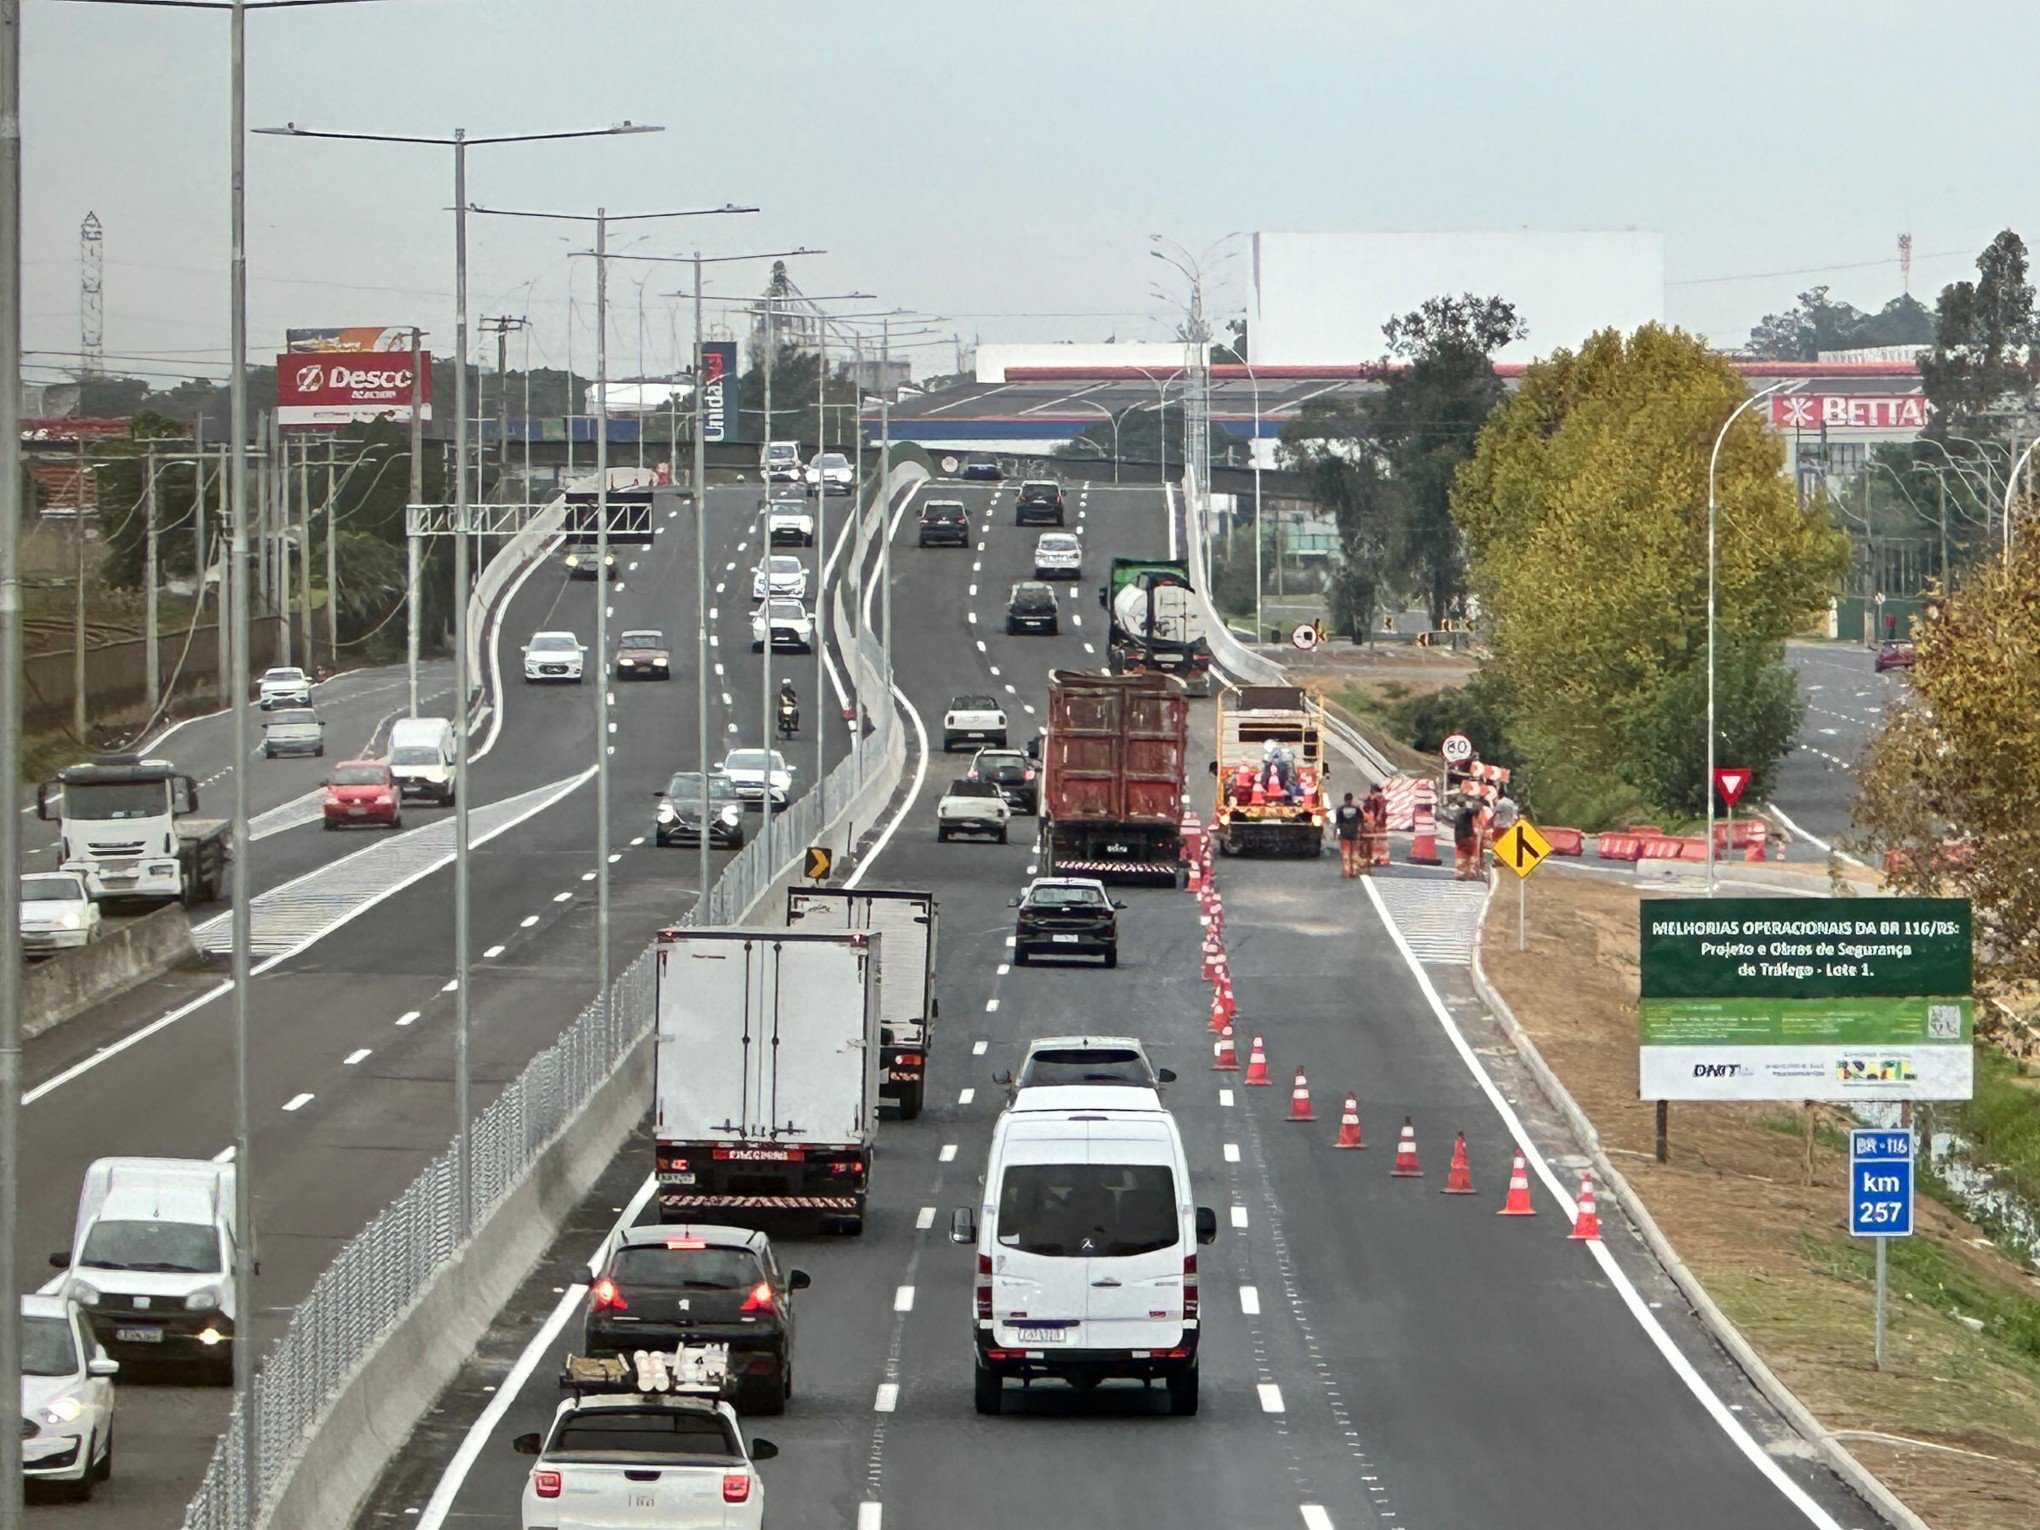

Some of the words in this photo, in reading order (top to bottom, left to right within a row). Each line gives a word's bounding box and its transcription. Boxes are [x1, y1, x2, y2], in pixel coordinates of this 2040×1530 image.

[1652, 921, 1739, 936] MELHORIAS
[1742, 921, 1852, 936] OPERACIONAIS
[1855, 921, 1877, 936] DA
[1880, 921, 1900, 935] BR
[1701, 942, 1755, 959] Projeto
[1757, 944, 1767, 956] e
[1769, 942, 1813, 956] Obras
[1815, 942, 1835, 956] de
[1838, 942, 1912, 959] Segurança
[1759, 962, 1814, 980] Tráfego
[1826, 962, 1858, 977] Lote
[1860, 1201, 1902, 1223] 257
